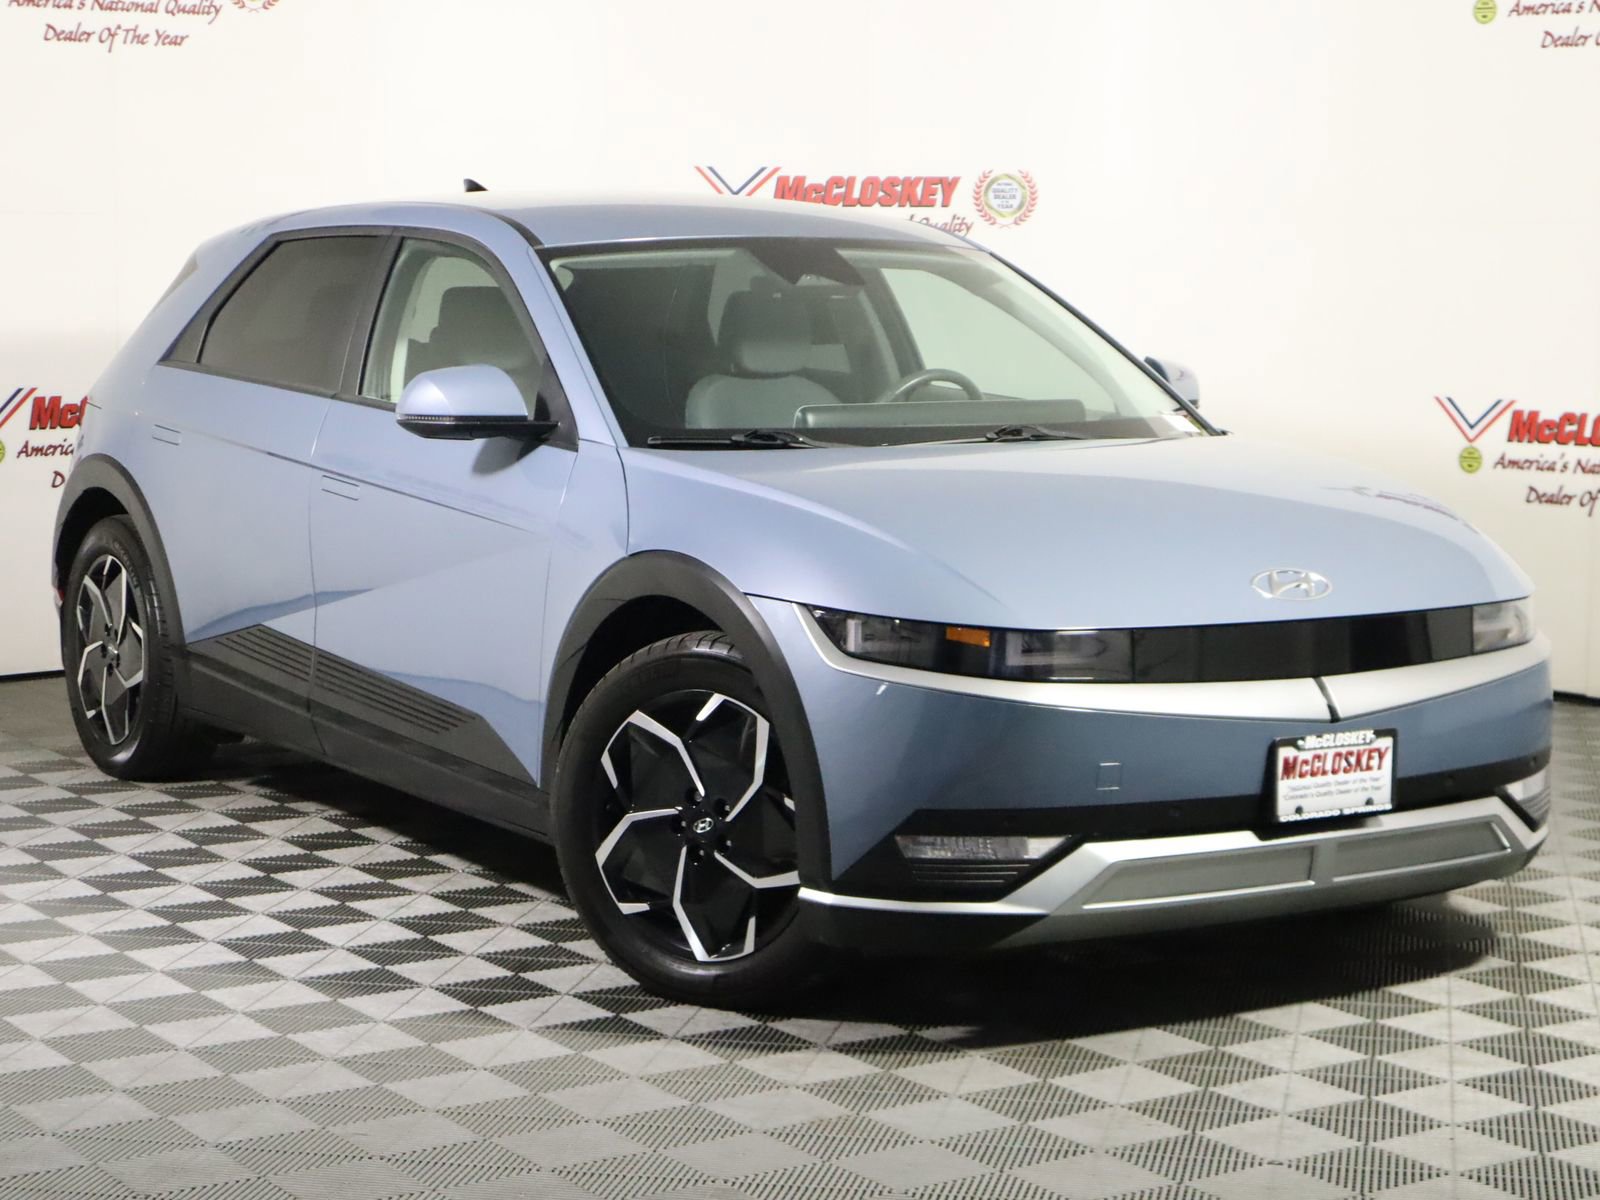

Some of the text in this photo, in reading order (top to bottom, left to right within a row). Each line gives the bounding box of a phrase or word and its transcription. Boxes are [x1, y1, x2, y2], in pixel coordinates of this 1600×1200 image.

[91, 0, 160, 13] National
[164, 0, 222, 25] Quality
[43, 22, 189, 53] Dealer Of The Year
[1540, 25, 1593, 48] Dealer
[774, 175, 961, 208] McCLOSKEY
[1494, 452, 1569, 473] America's
[1525, 485, 1576, 506] Dealer
[1304, 729, 1374, 749] McCLOSKEY
[1280, 746, 1390, 780] McCLOSKEY
